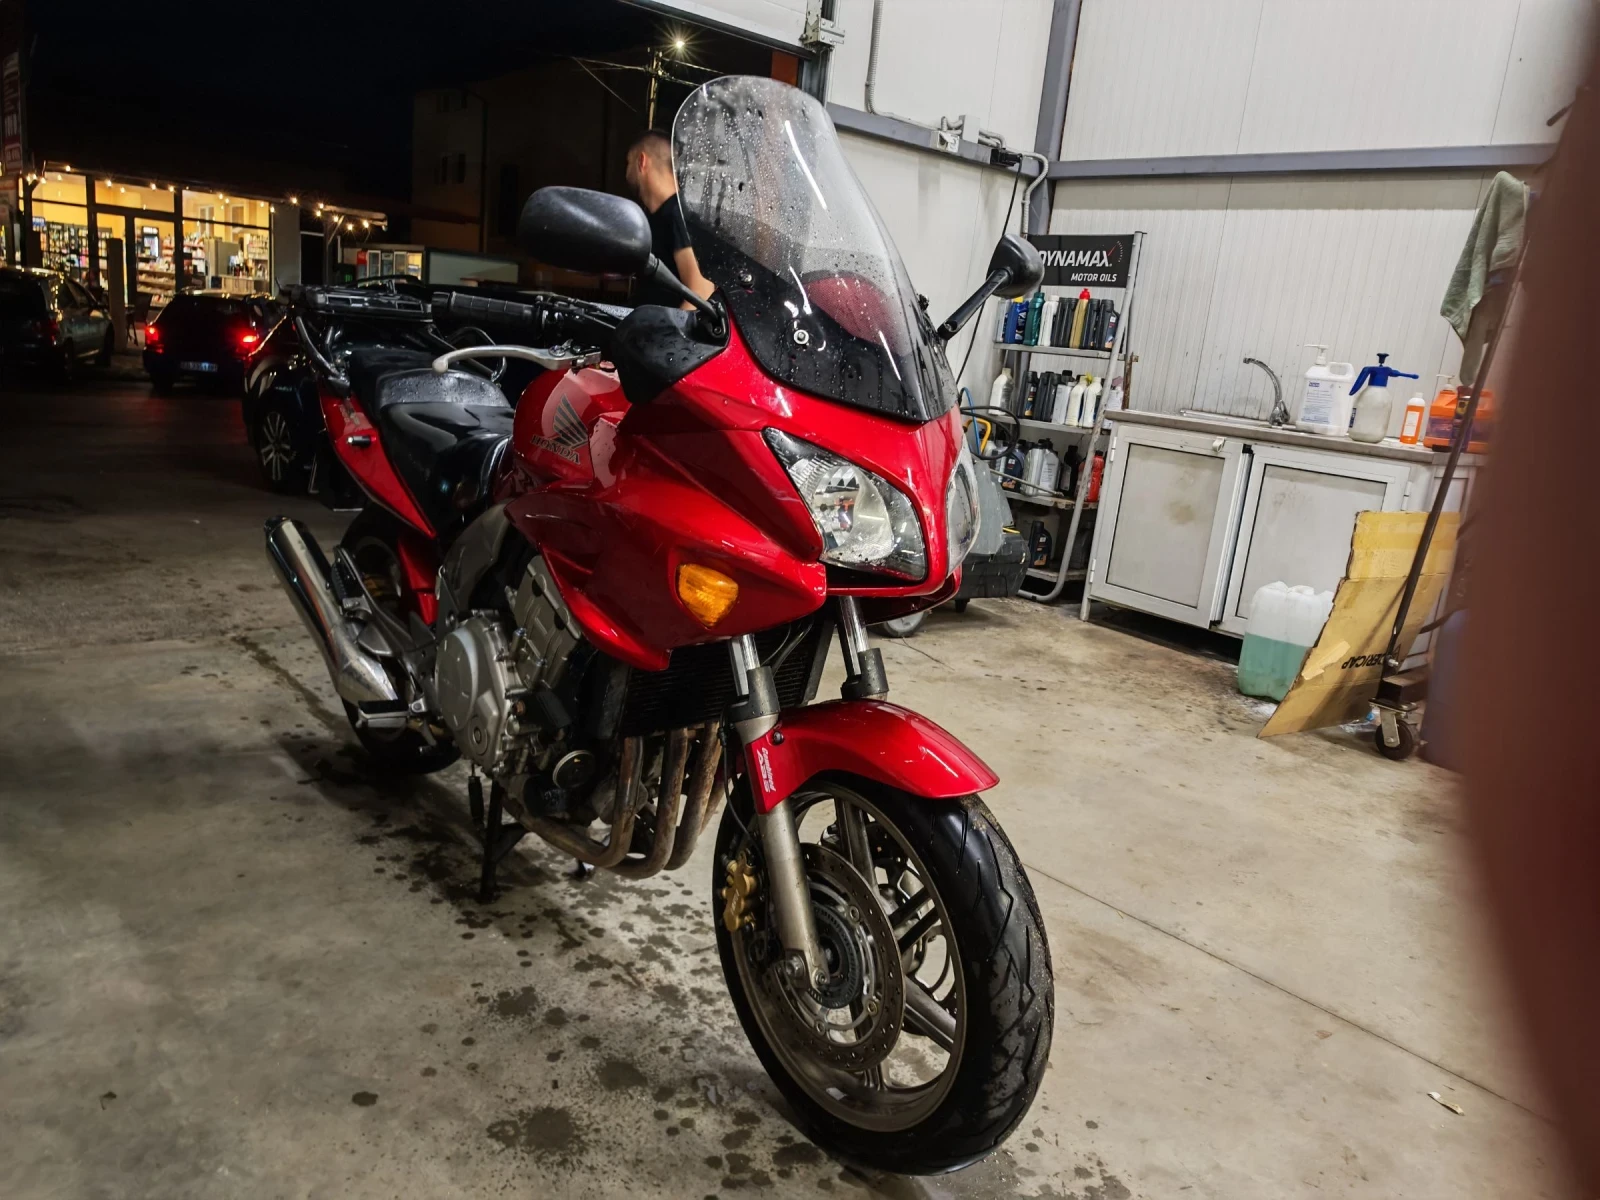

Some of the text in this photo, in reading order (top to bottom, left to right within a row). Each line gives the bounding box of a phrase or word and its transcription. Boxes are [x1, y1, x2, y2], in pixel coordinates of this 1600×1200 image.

[1070, 273, 1117, 282] MOTOR OILS
[530, 435, 580, 465] HONDA
